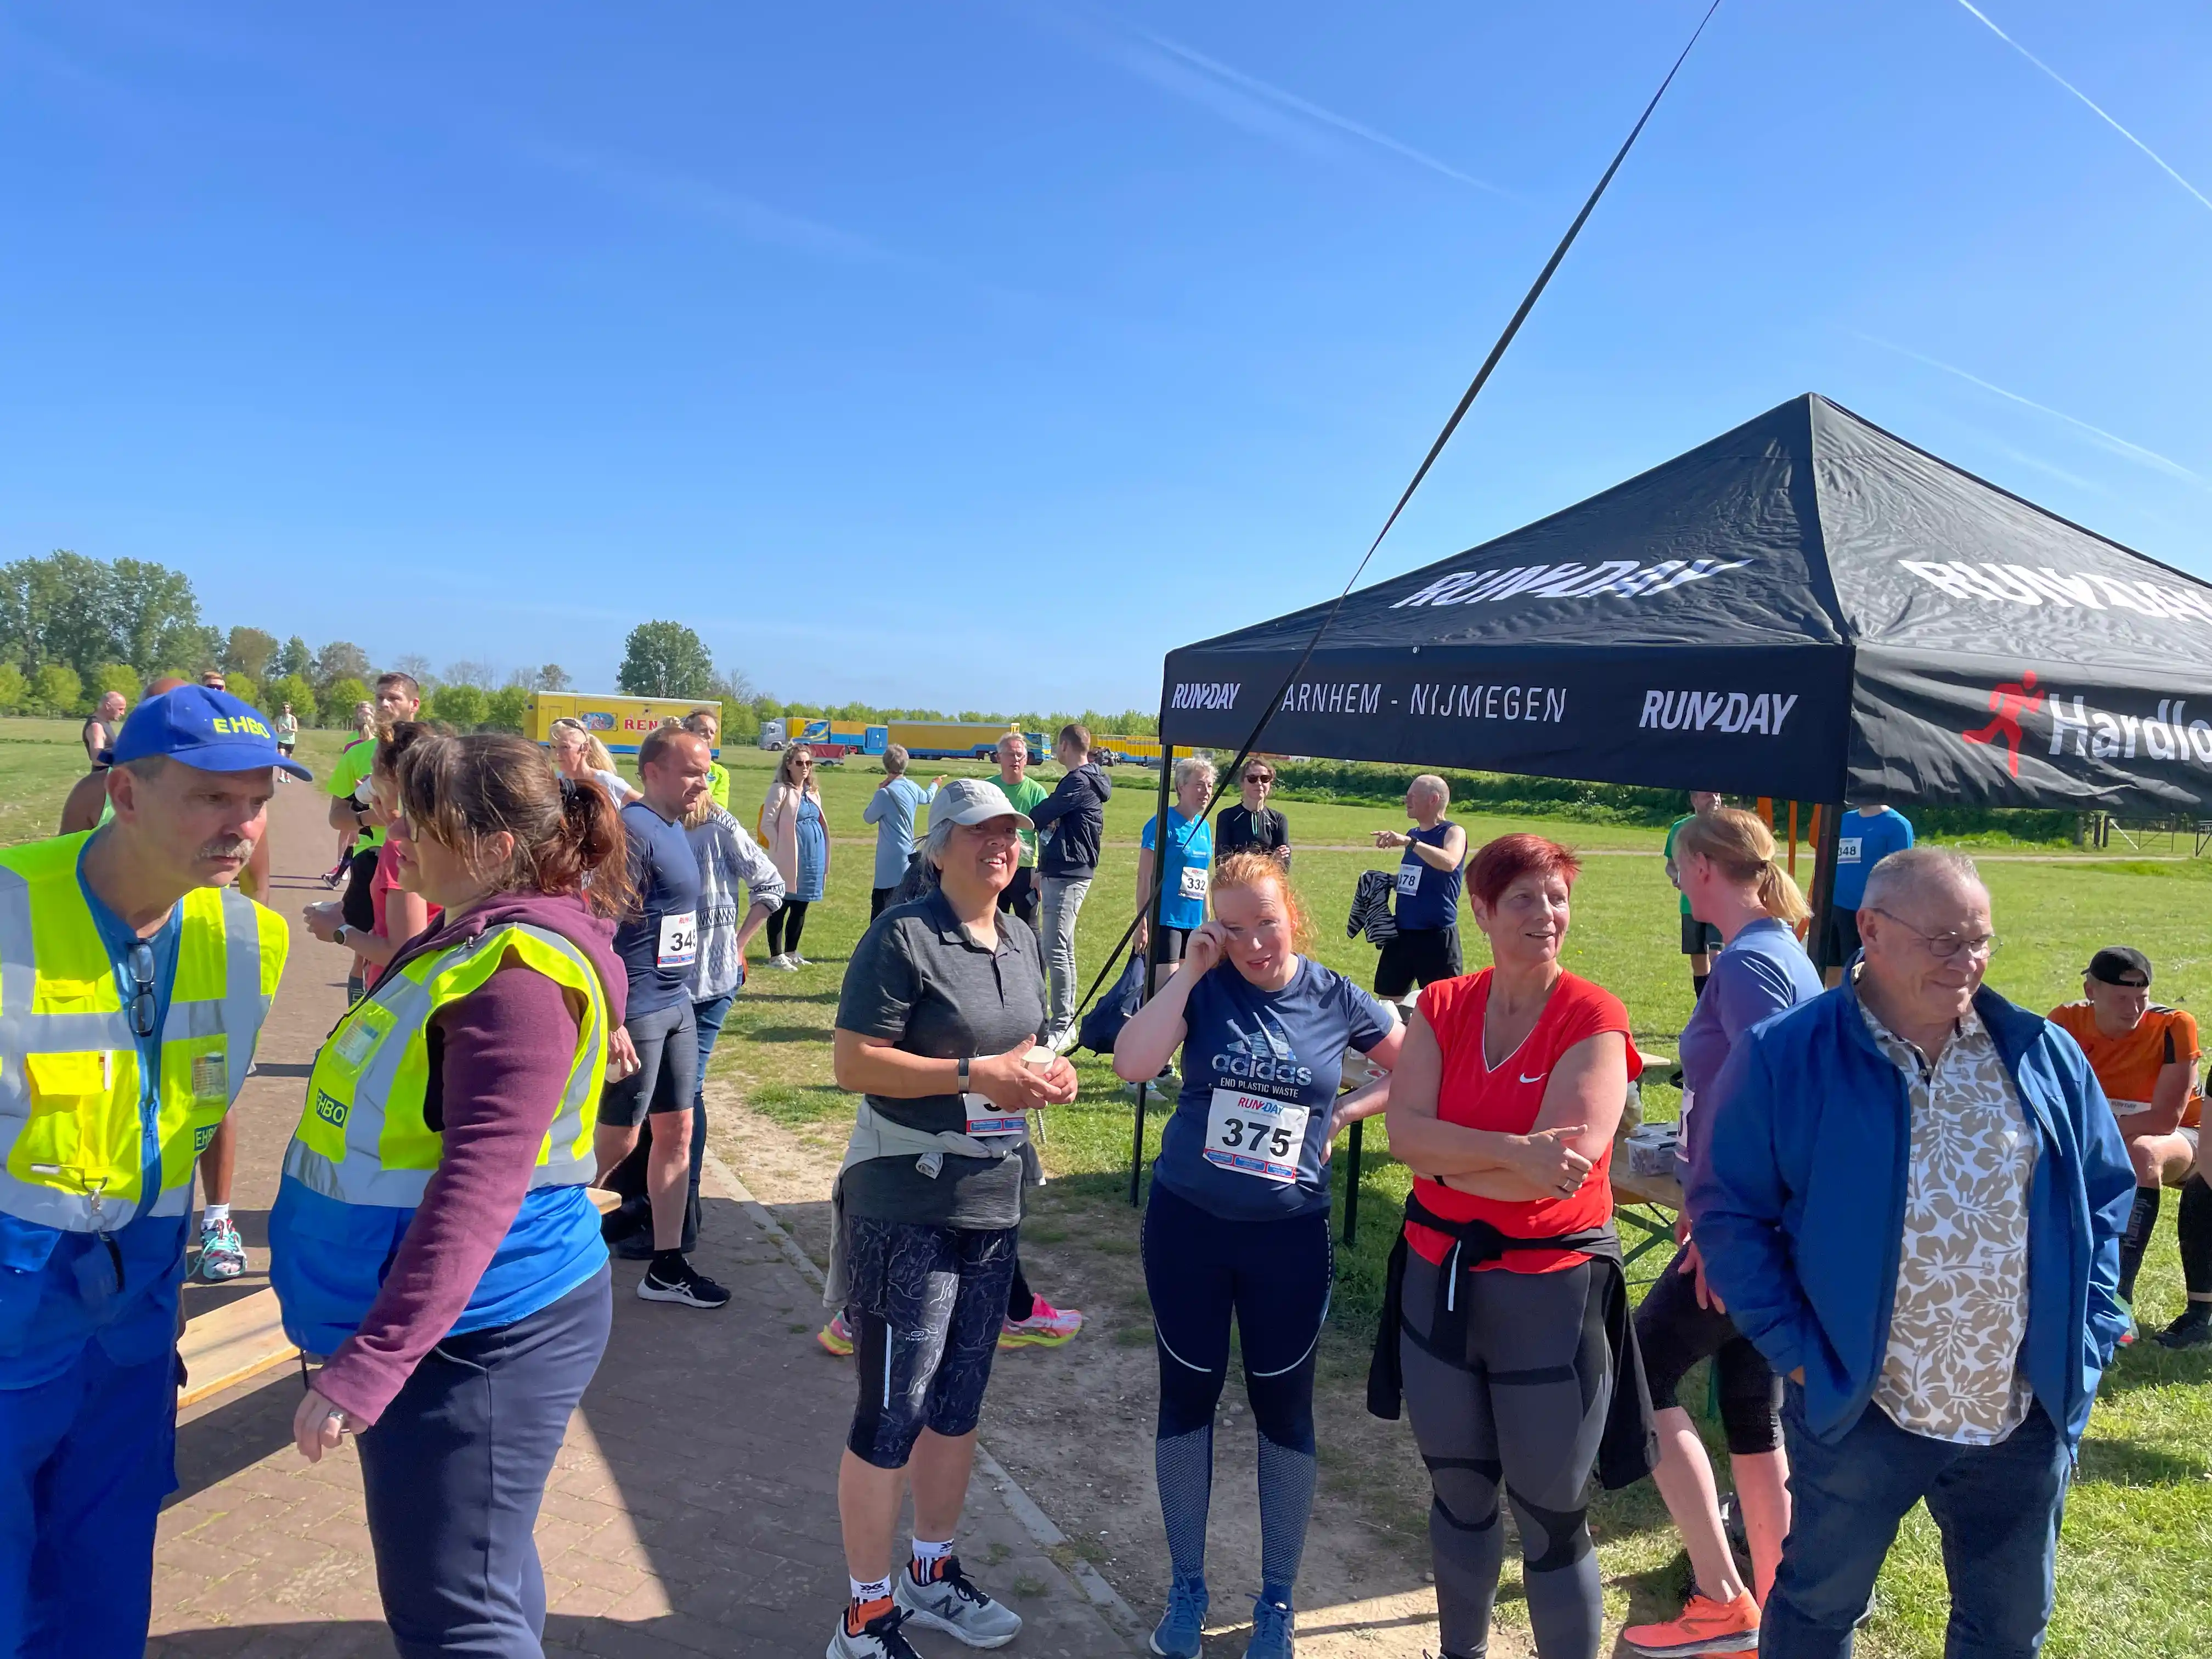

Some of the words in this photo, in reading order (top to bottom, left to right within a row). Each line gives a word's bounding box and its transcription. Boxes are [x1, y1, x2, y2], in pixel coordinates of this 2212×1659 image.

[1171, 683, 1241, 709] RUN2DAY
[1281, 684, 1381, 713] ARNHEM
[1410, 684, 1566, 723] NIJMEGEN
[1639, 690, 1799, 735] RUN2DAY
[213, 716, 270, 738] EHBO
[1187, 878, 1205, 890] 332
[1212, 1053, 1312, 1086] adidas
[1220, 1077, 1235, 1087] END
[1238, 1080, 1269, 1093] PLASTIC
[1272, 1085, 1299, 1098] WASTE
[196, 1126, 218, 1147] EHB
[1222, 1118, 1291, 1157] 375
